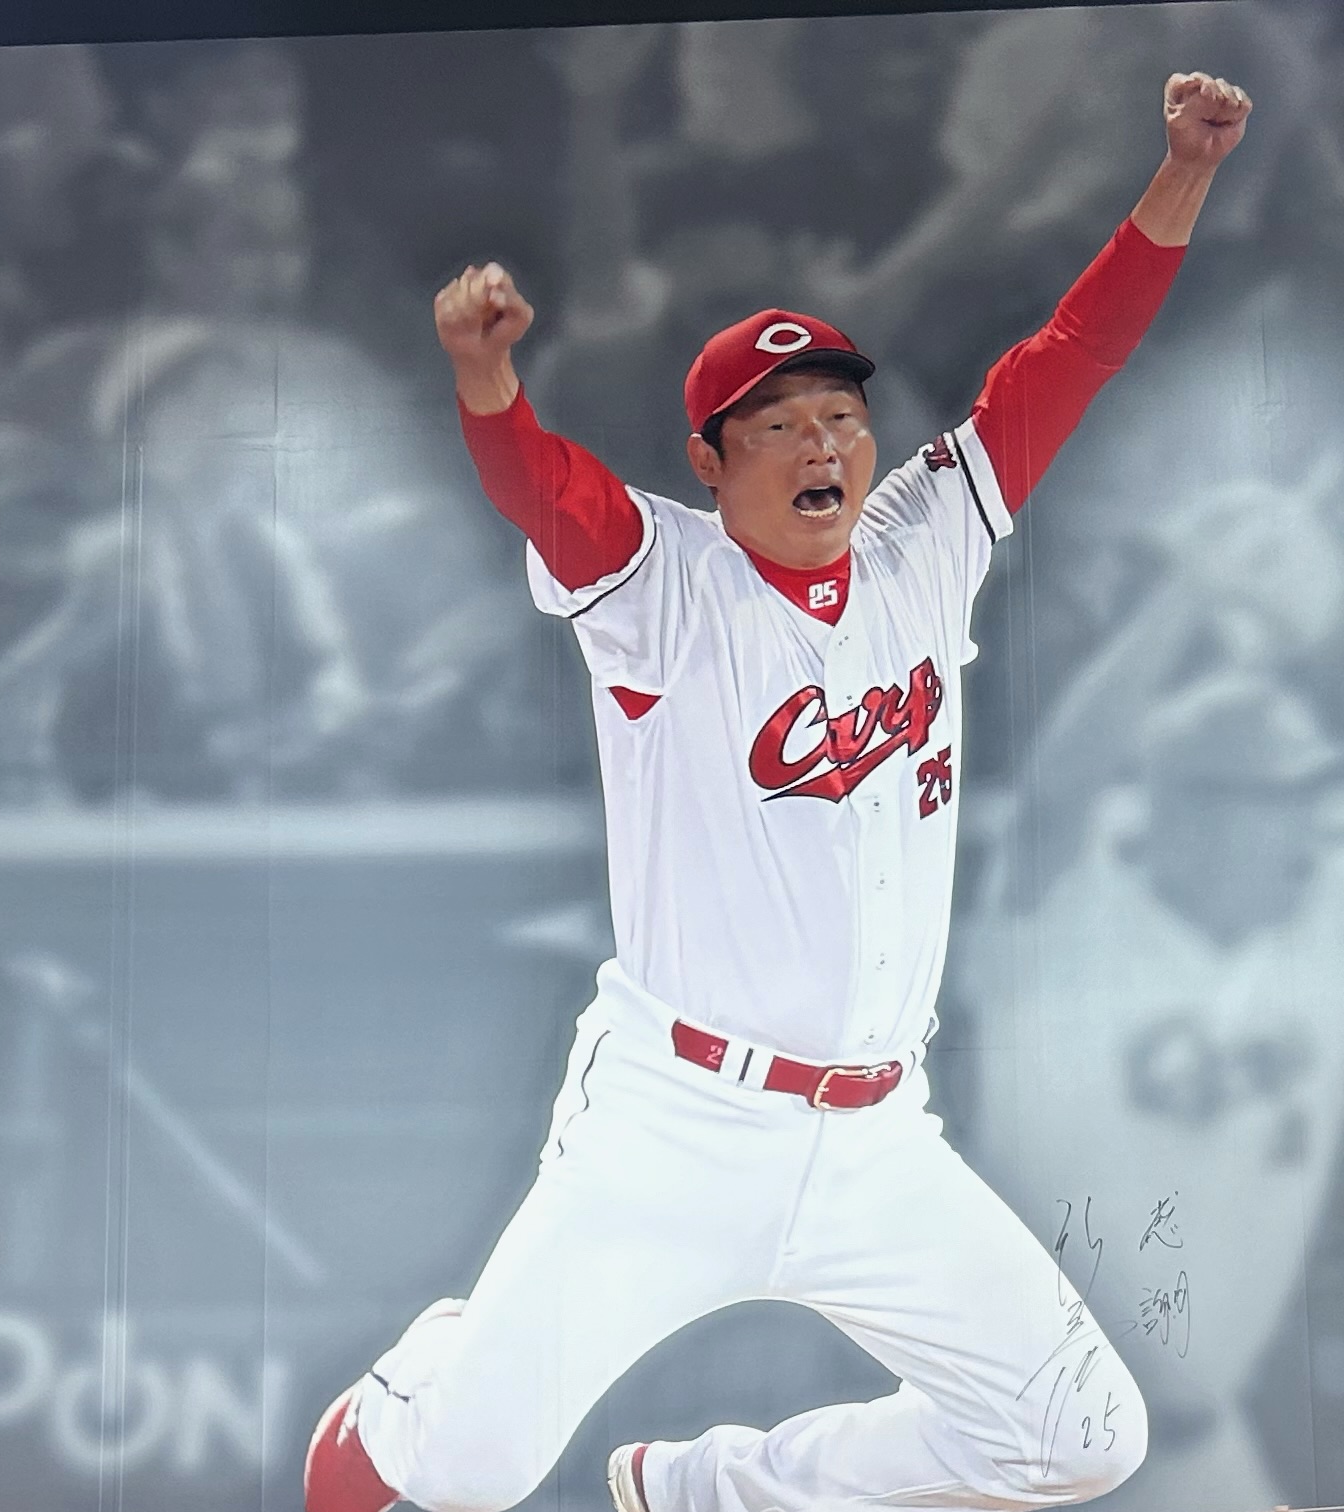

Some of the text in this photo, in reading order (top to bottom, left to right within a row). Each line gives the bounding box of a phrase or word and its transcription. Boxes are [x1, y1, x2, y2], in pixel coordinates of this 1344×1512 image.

[808, 581, 838, 609] 25
[749, 657, 943, 803] Carp
[1081, 1392, 1121, 1452] 25
